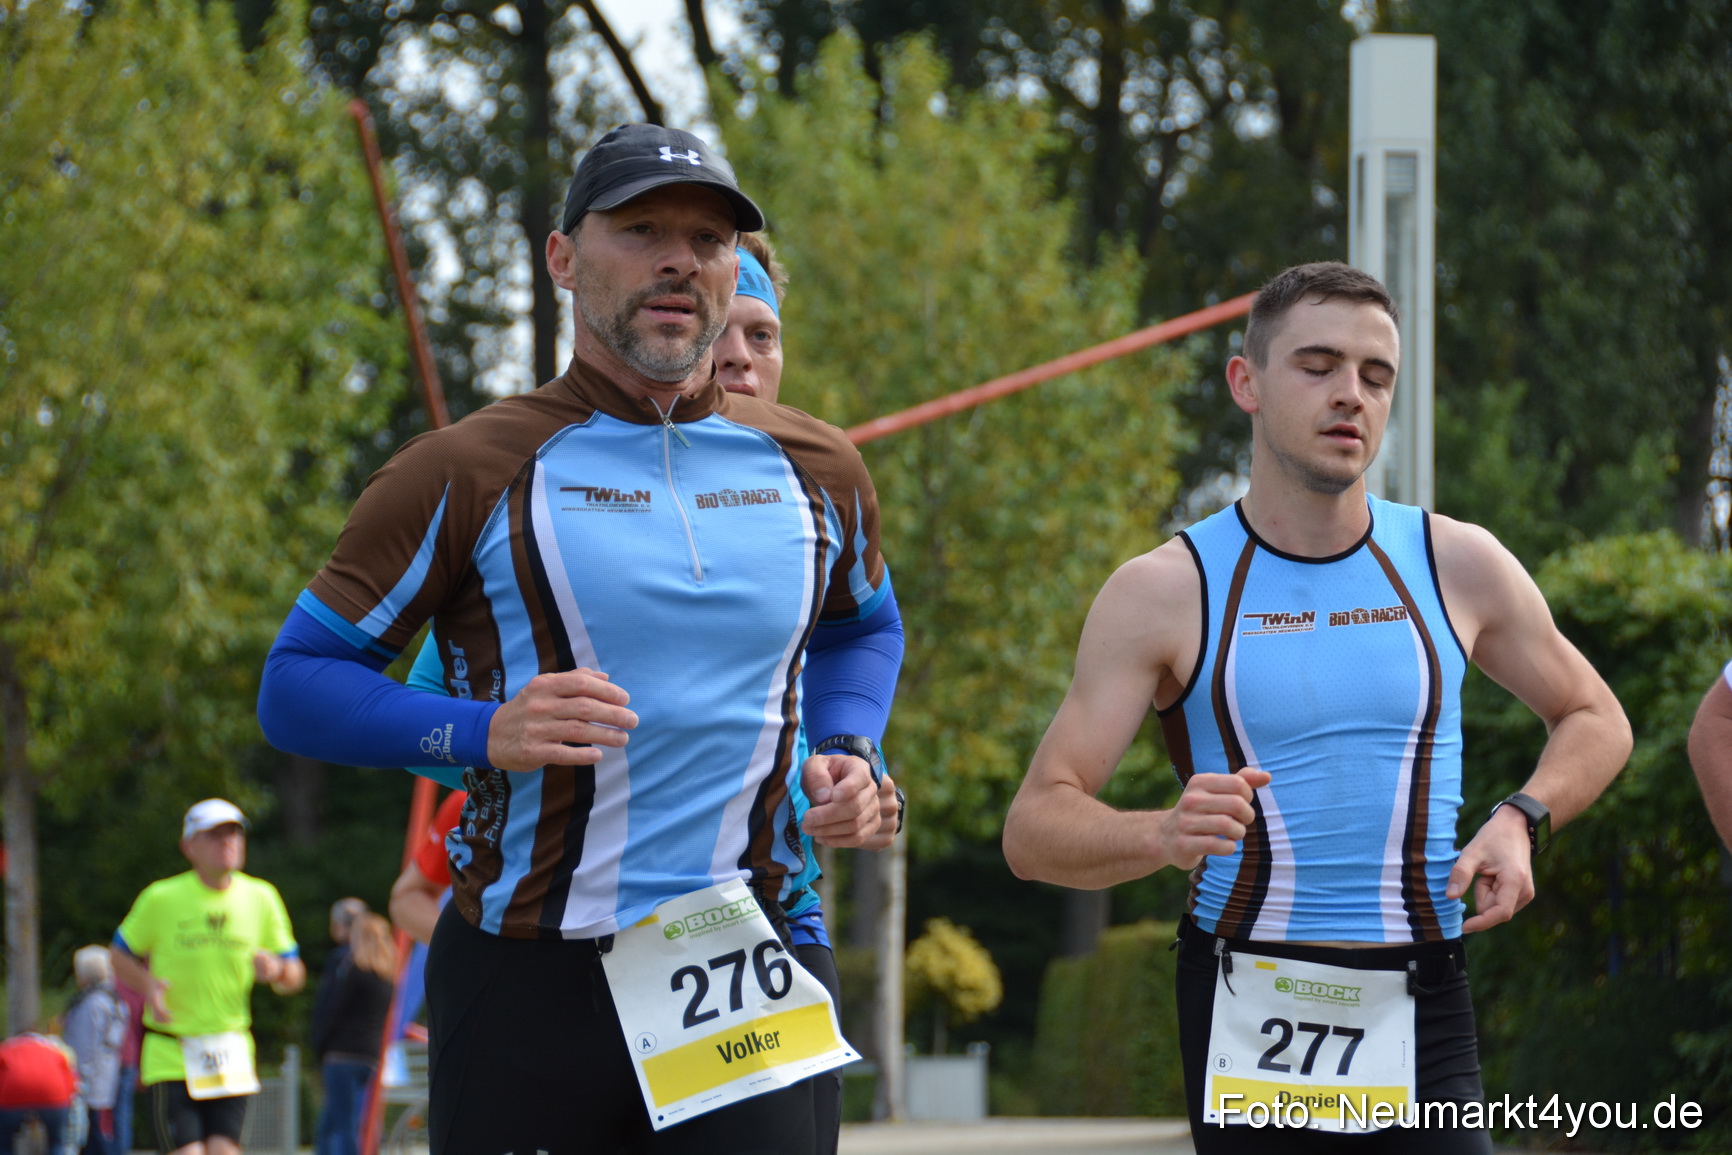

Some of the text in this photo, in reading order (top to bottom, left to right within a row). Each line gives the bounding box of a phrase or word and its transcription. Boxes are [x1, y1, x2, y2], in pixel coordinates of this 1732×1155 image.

[740, 488, 782, 506] RACER
[1370, 605, 1408, 624] RACER
[684, 895, 760, 933] BOCK
[722, 920, 740, 929] smart
[670, 938, 793, 1030] 276
[1294, 979, 1362, 1002] BOCK
[1293, 995, 1314, 1003] inspired
[642, 1037, 651, 1049] A
[716, 1030, 781, 1065] Volker
[1257, 1017, 1365, 1076] 277
[1219, 1058, 1227, 1068] B
